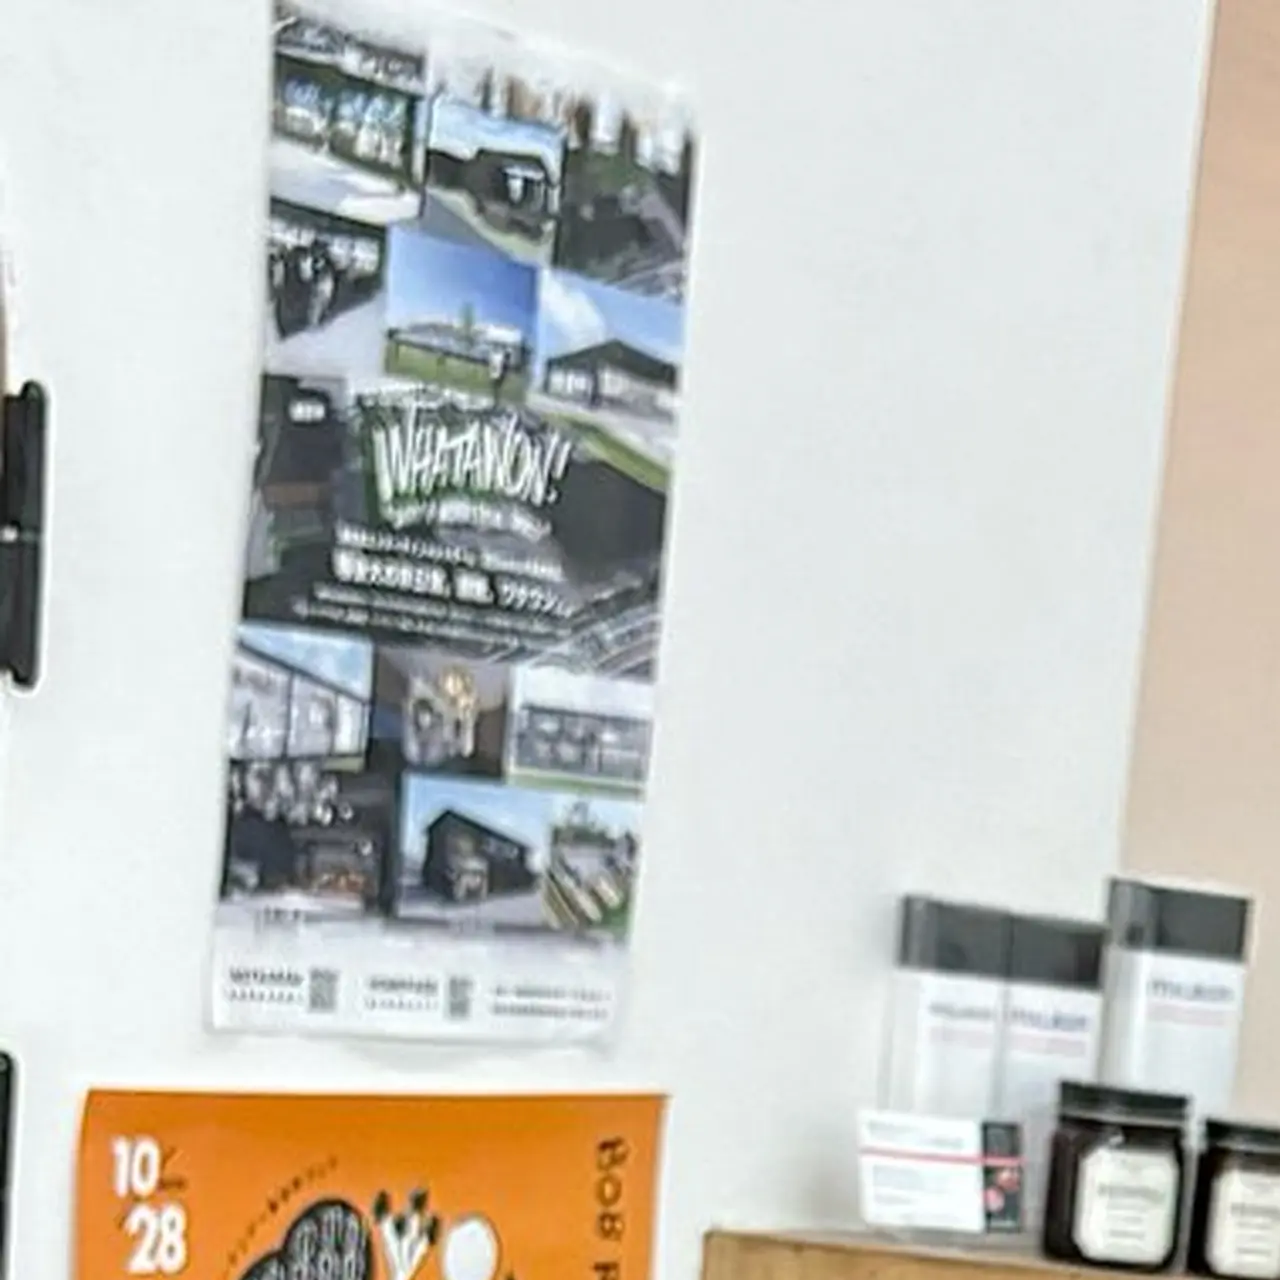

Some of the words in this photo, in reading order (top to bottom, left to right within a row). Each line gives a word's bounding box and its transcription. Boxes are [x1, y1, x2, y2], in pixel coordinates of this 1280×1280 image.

[112, 1135, 161, 1197] 10
[596, 1135, 629, 1241] BOB
[124, 1202, 188, 1274] 28
